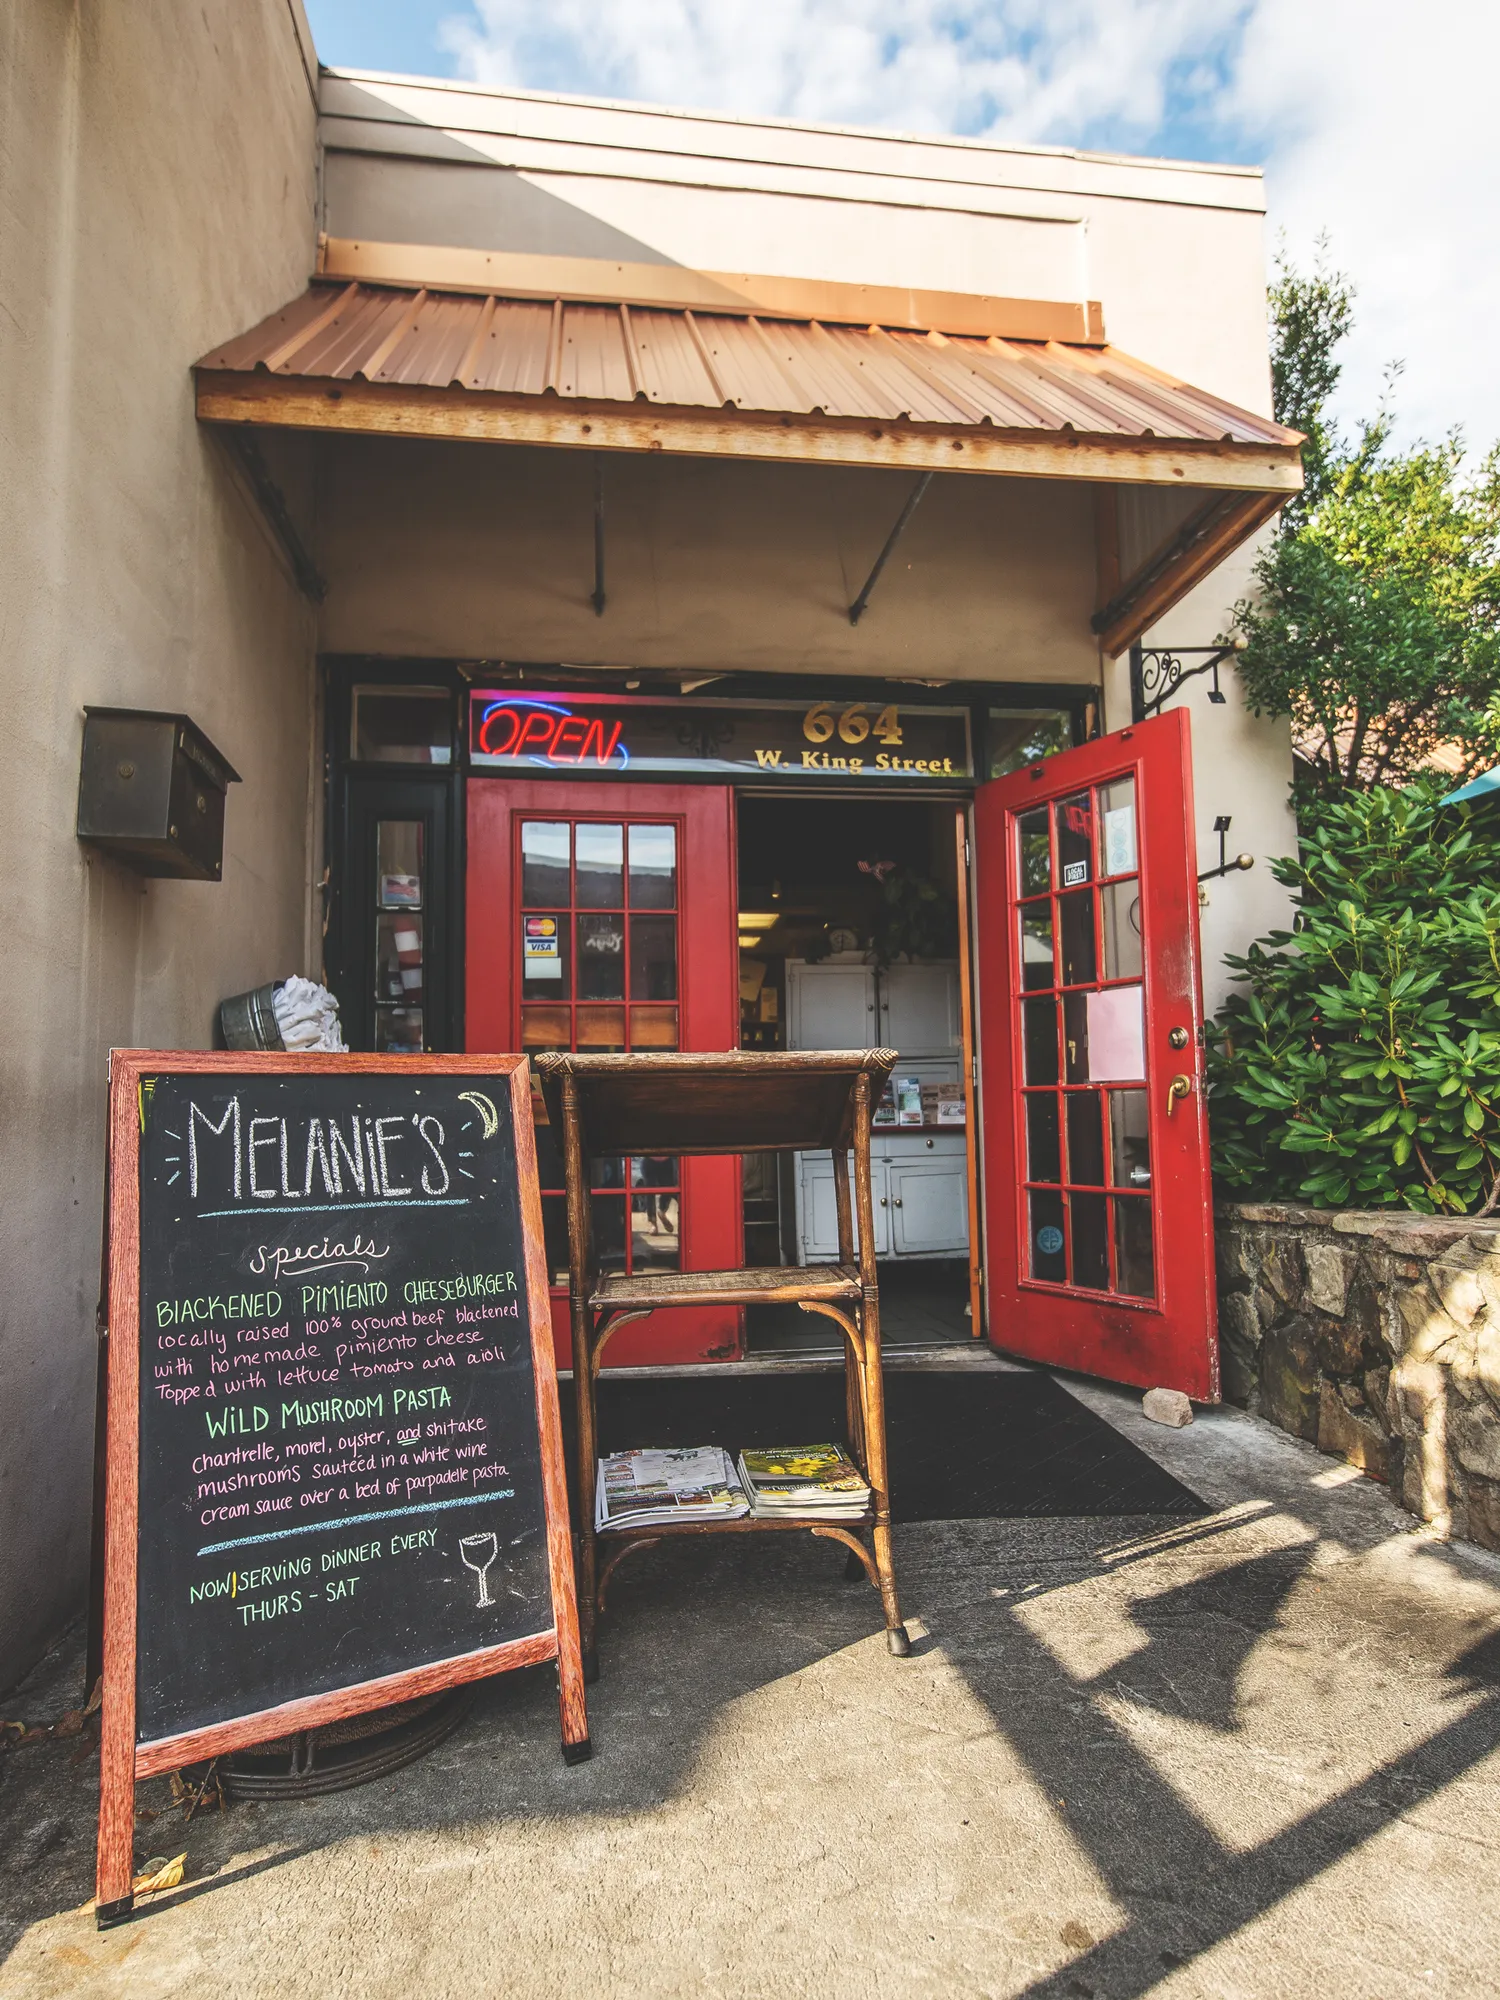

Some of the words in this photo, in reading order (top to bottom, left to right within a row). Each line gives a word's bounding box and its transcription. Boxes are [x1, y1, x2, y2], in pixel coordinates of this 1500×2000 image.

[479, 708, 623, 766] OPEN
[803, 702, 903, 745] 664
[754, 749, 789, 768] W.
[801, 751, 864, 774] King
[875, 753, 952, 773] Street
[1067, 865, 1083, 875] LOCAL
[531, 943, 552, 951] VISA
[404, 1271, 518, 1305] CHEESEBURGER
[158, 1329, 227, 1354] locally
[237, 1322, 289, 1342] raised
[305, 1316, 342, 1336] 100%
[351, 1311, 408, 1340] ground
[412, 1309, 446, 1326] beef
[456, 1300, 519, 1324] blackened
[154, 1357, 193, 1378] with
[336, 1334, 417, 1365] pimiento
[426, 1330, 484, 1346] cheese
[155, 1380, 217, 1406] Topped
[225, 1371, 266, 1394] with
[278, 1365, 339, 1386] lettuce
[350, 1358, 414, 1378] tomato
[422, 1353, 456, 1370] and
[467, 1346, 506, 1365] aioli
[281, 1394, 383, 1429] MUSHROOM
[393, 1385, 452, 1415] PASTA
[285, 1436, 333, 1457] morel,
[338, 1430, 391, 1458] oyster,
[397, 1423, 421, 1442] and
[426, 1417, 487, 1437] shitake
[198, 1465, 301, 1498] mushrooms
[381, 1454, 395, 1469] in
[399, 1455, 409, 1465] a
[412, 1446, 450, 1465] white
[455, 1442, 488, 1459] wine
[253, 1495, 293, 1515] sauce
[300, 1487, 335, 1507] over
[338, 1487, 350, 1500] a
[355, 1479, 381, 1499] bed
[386, 1478, 401, 1495] of
[405, 1467, 469, 1500] parpadelle
[391, 1528, 438, 1555] EVERY
[236, 1591, 302, 1626] THURS
[325, 1577, 361, 1602] SAT
